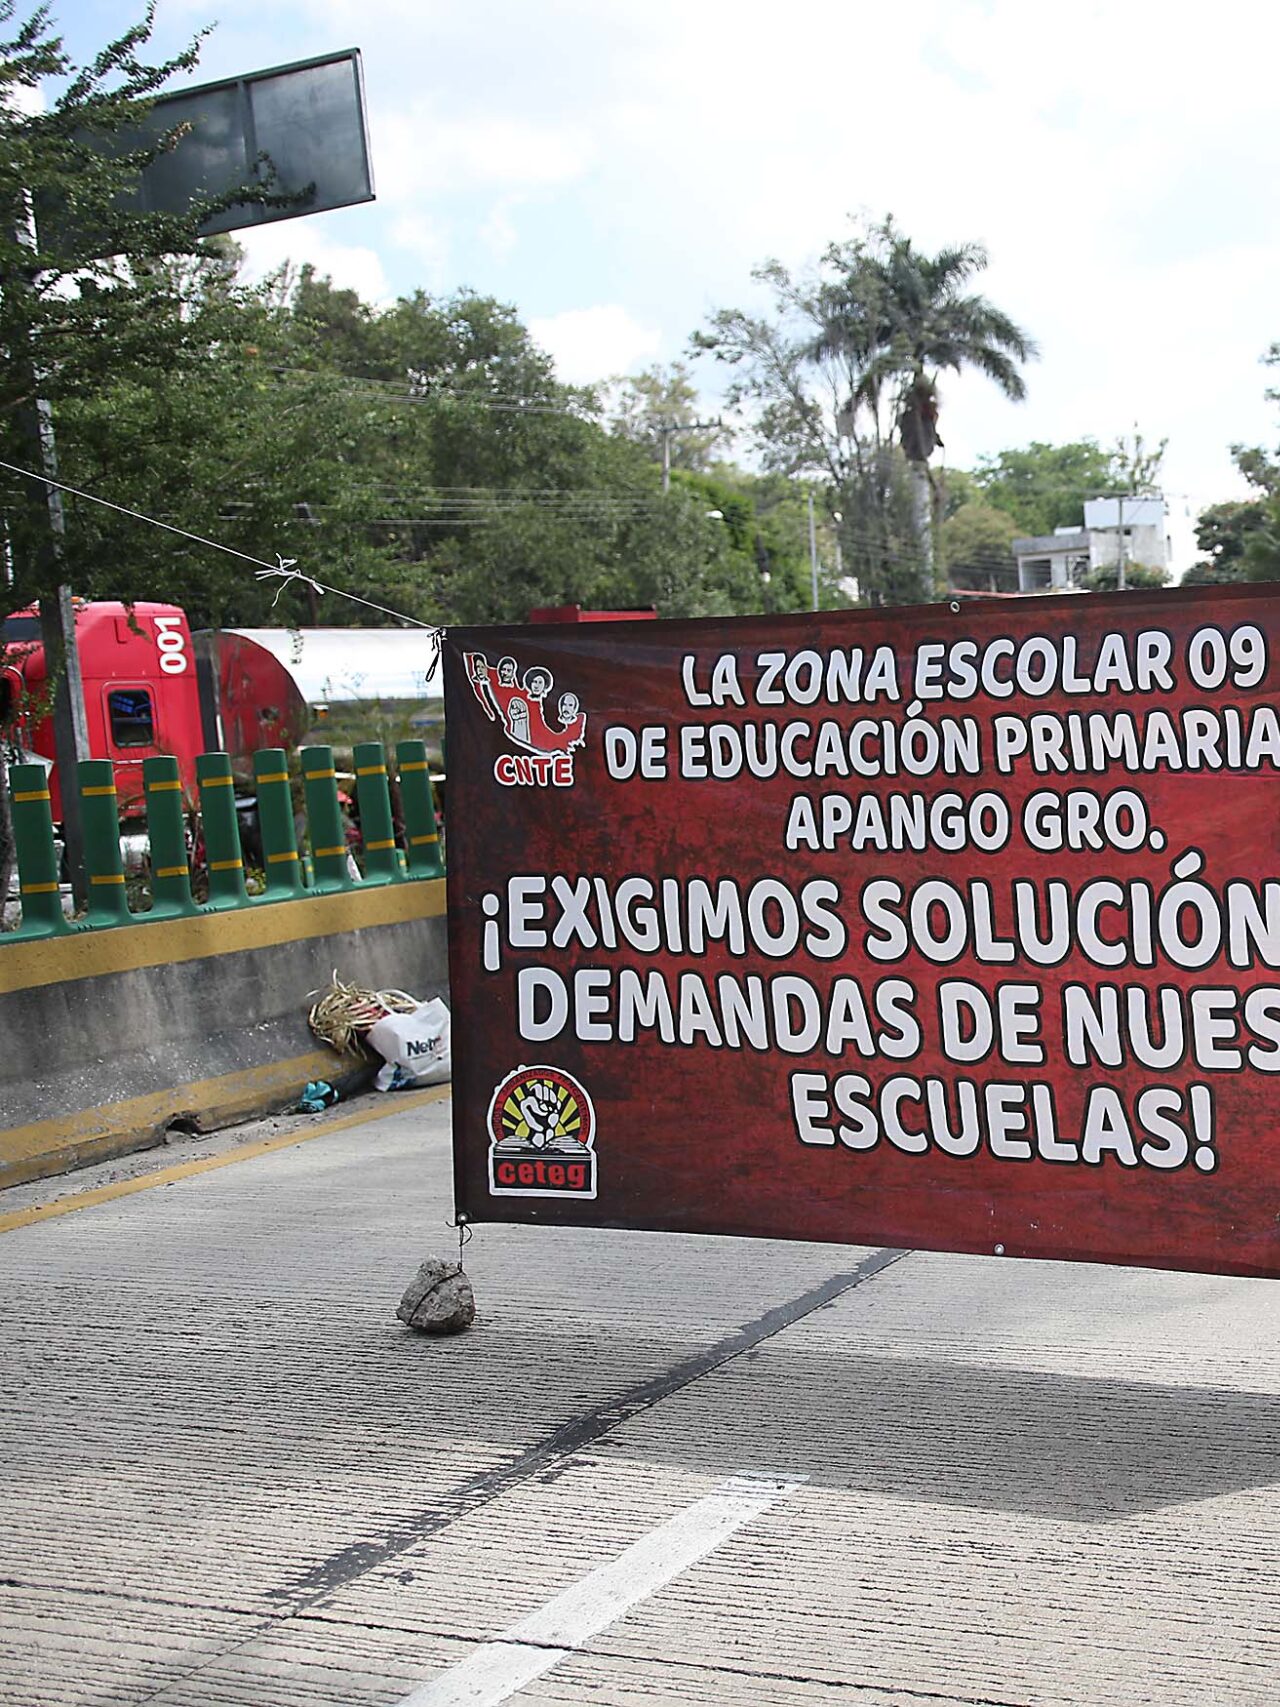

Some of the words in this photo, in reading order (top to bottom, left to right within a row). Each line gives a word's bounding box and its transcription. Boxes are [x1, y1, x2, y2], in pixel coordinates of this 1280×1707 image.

[153, 616, 187, 674] 001
[682, 654, 746, 708] LA
[755, 646, 900, 704] ZONA
[914, 630, 1174, 699] ESCOLAR
[1188, 625, 1266, 689] 09
[494, 755, 574, 787] CNTE
[605, 726, 666, 780] DE
[680, 699, 980, 778] EDUCACIÓN
[786, 792, 1009, 851] APANGO
[1024, 790, 1164, 850] GRO.
[482, 875, 846, 971] ¡EXIGIMOS
[518, 967, 920, 1058] DEMANDAS
[939, 981, 1044, 1063] DE
[791, 1073, 1215, 1171] ESCUELAS!
[498, 1161, 586, 1188] ceteg
